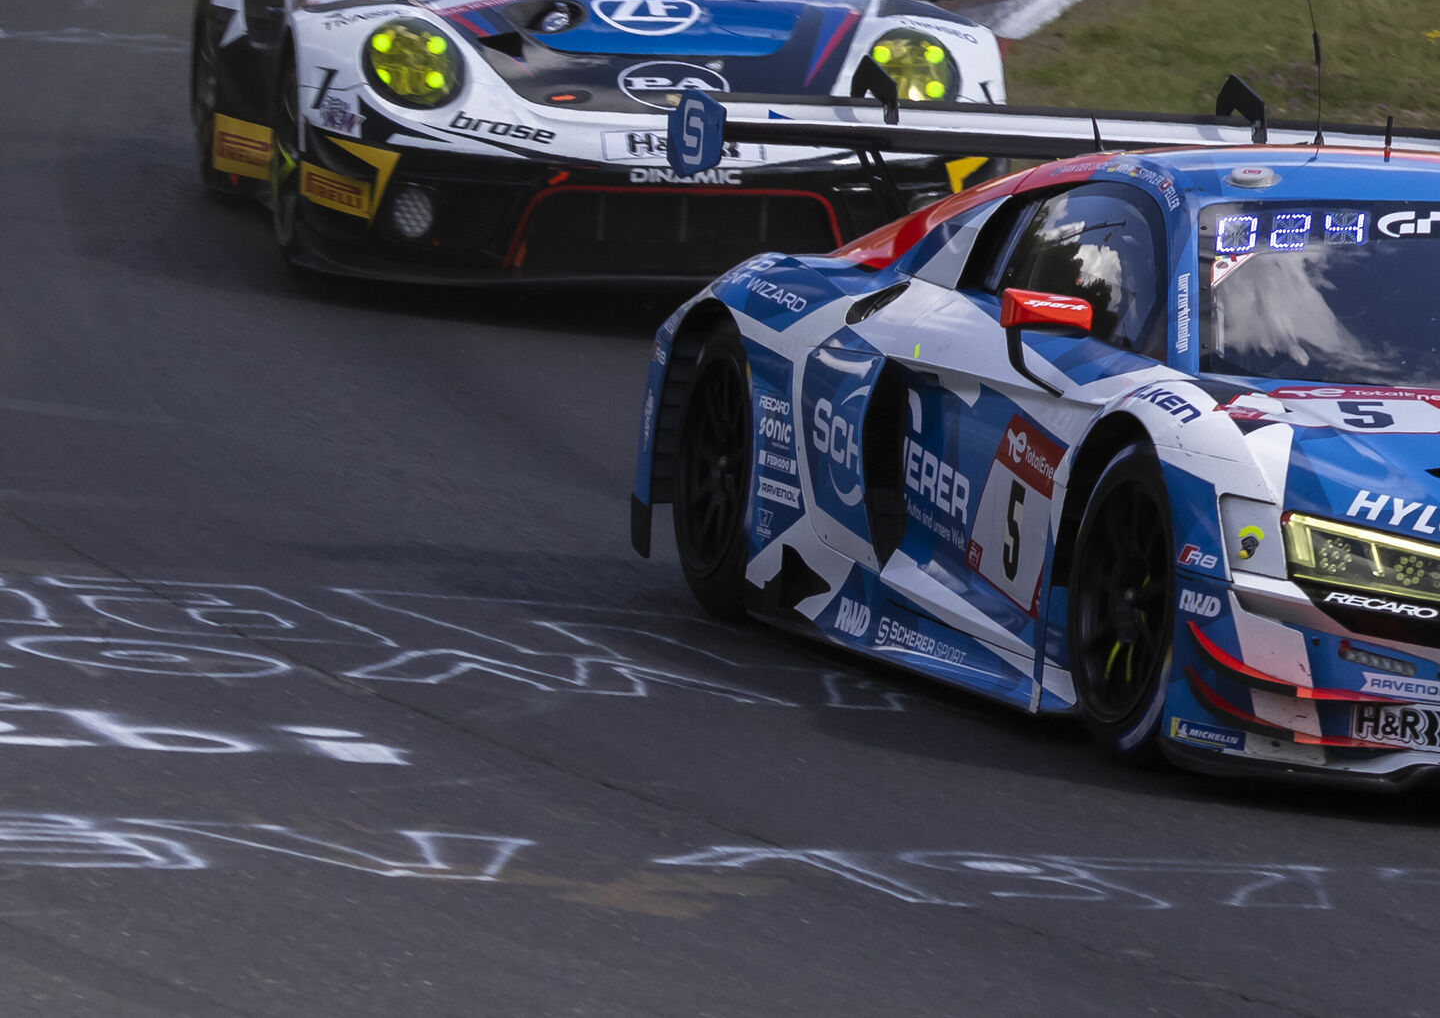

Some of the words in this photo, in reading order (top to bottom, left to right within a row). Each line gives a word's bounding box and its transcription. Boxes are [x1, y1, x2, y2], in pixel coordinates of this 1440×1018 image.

[450, 111, 557, 145] brose
[745, 276, 808, 313] WIZARD
[759, 395, 791, 416] RECARO
[1337, 400, 1395, 429] 5
[761, 482, 798, 502] RAVENOL
[1002, 479, 1026, 583] 5
[834, 596, 872, 638] RWD
[1178, 588, 1222, 618] RWD
[1323, 590, 1440, 620] RECARO
[889, 620, 936, 655] SCHERER
[934, 641, 968, 664] SPORT
[1188, 728, 1240, 744] MICHELIN
[1356, 704, 1421, 741] H&R
